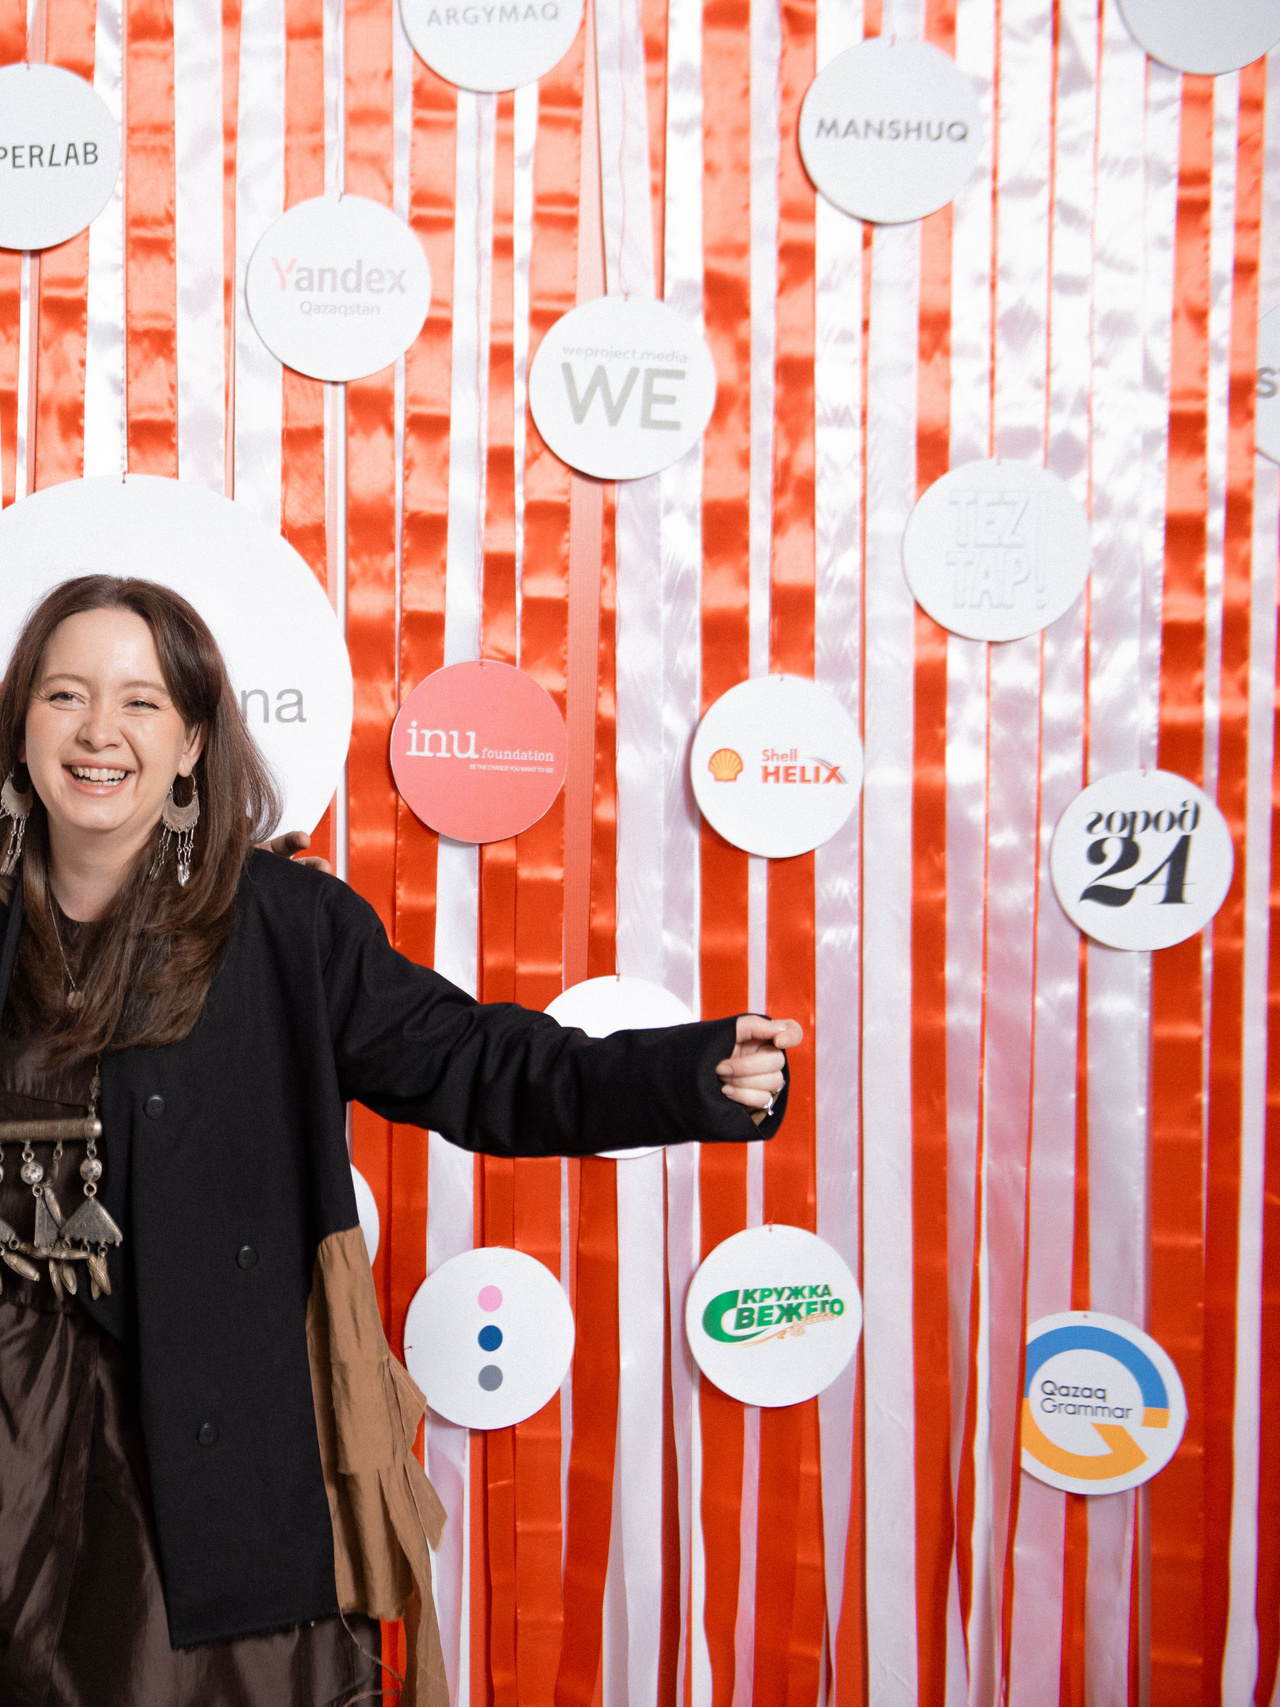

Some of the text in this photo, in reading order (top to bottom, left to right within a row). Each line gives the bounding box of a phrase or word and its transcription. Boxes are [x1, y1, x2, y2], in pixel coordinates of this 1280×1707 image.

[426, 3, 559, 26] ARGYMAQ
[815, 118, 969, 144] MANSHUQ
[272, 257, 407, 295] Yandex
[299, 301, 380, 318] Qazaqstan
[562, 346, 688, 364] weproject.media
[561, 362, 686, 431] WE
[406, 720, 555, 762] inu foundation
[762, 749, 798, 762] Shell
[762, 764, 847, 784] HELIX
[1079, 834, 1196, 908] 24
[741, 1284, 832, 1304] КРУЖКА
[1040, 1380, 1107, 1402] Qazaq
[1040, 1397, 1133, 1419] Grammar
